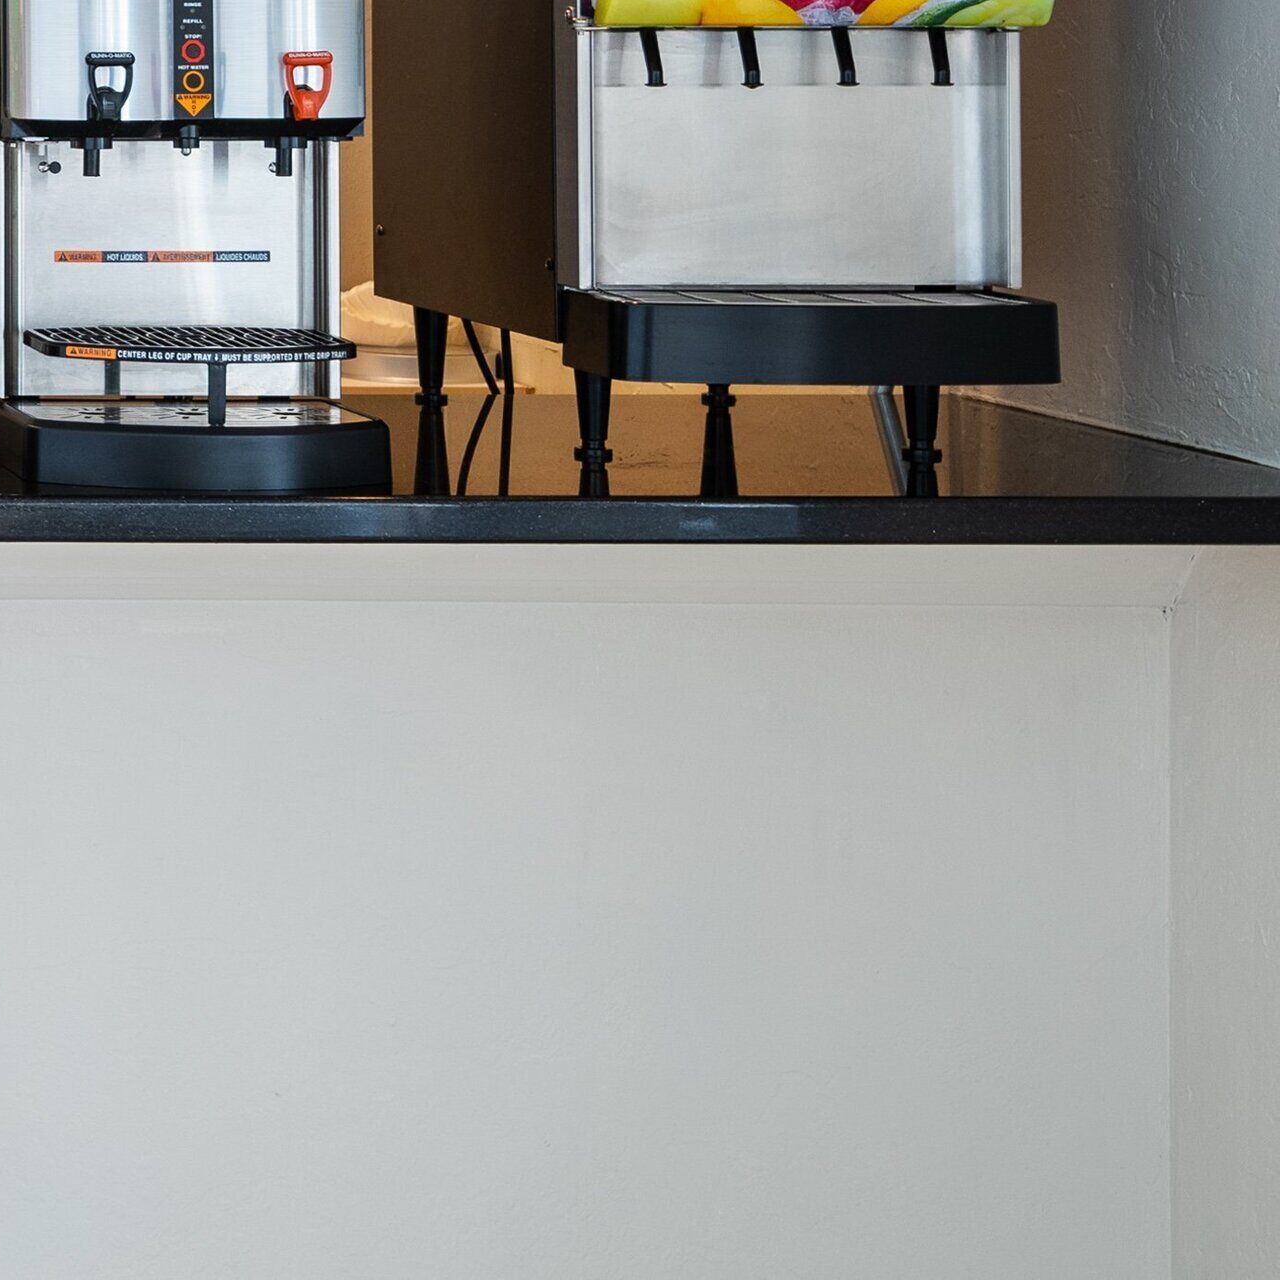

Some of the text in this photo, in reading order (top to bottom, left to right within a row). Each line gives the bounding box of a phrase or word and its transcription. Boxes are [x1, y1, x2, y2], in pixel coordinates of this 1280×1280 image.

[106, 253, 120, 261] HOT
[244, 253, 268, 262] CHAUDS
[78, 347, 112, 357] WARNING
[117, 350, 147, 359] CENTER
[148, 351, 163, 360] LEG
[164, 351, 175, 360] OF
[176, 352, 192, 361] CUP
[193, 353, 212, 362] TRAY
[221, 353, 241, 362] MUST
[242, 353, 253, 362] BE
[253, 352, 293, 362] SUPPORTED
[294, 351, 303, 361] BY
[304, 350, 316, 360] THE
[316, 350, 330, 360] DRIP
